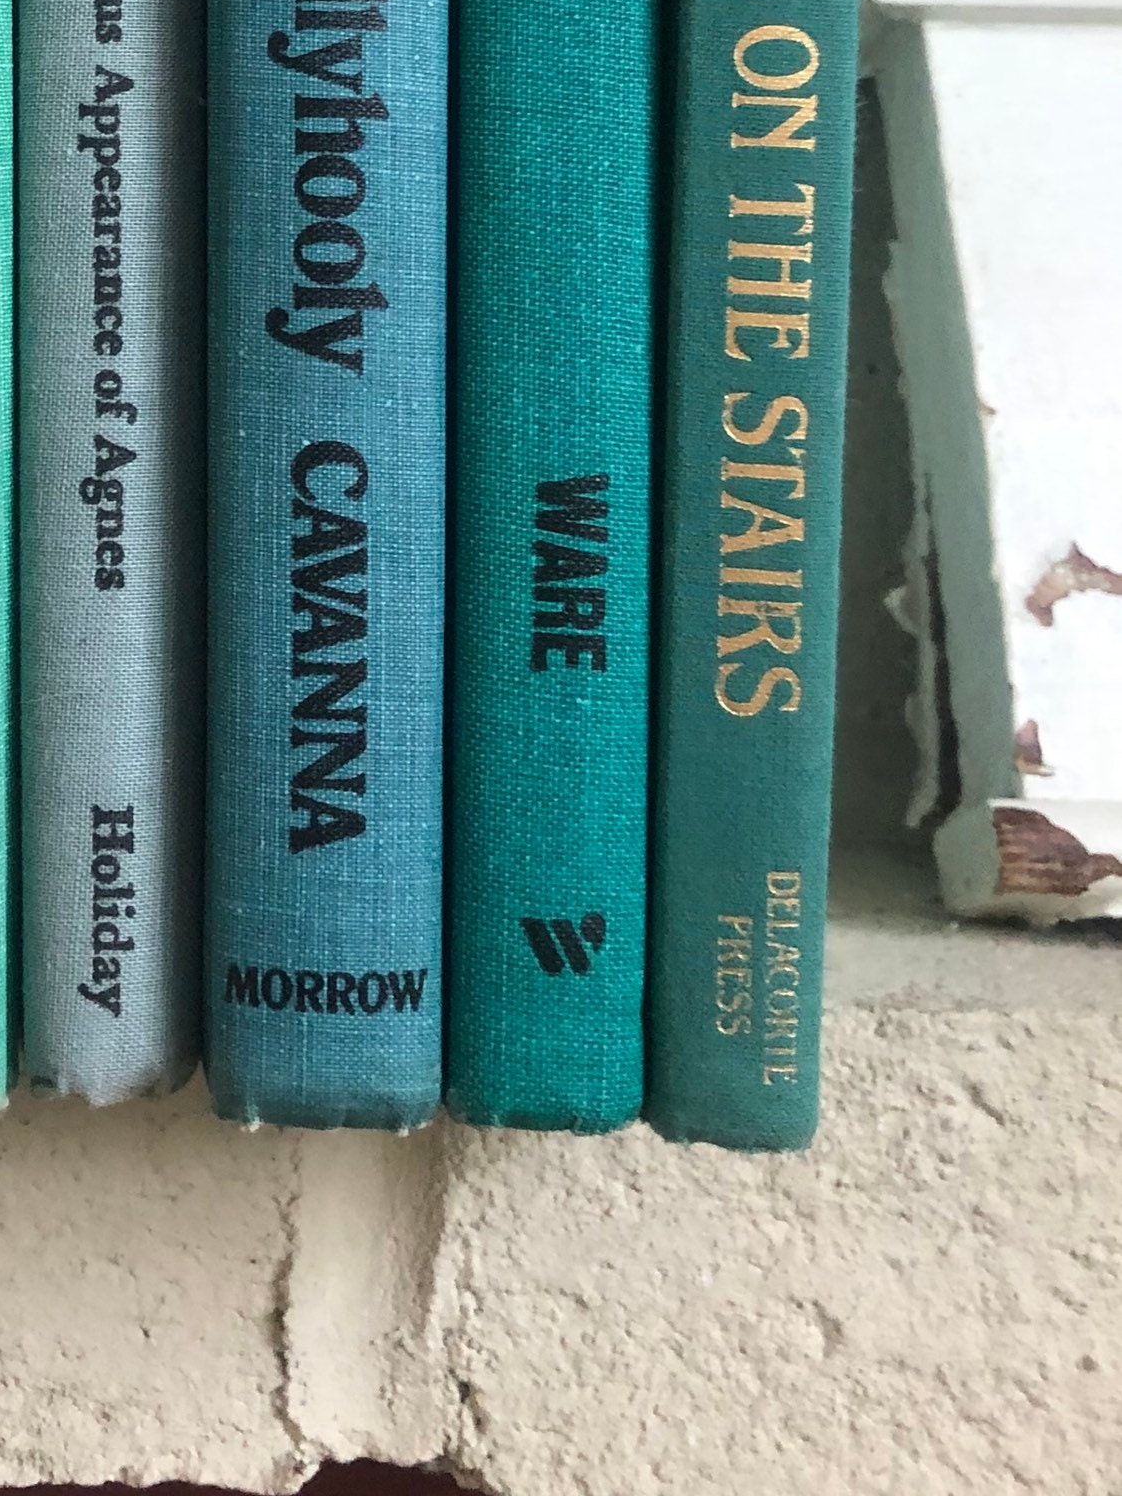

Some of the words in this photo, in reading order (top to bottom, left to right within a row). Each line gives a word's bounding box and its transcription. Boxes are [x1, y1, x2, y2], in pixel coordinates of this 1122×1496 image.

[730, 24, 820, 152] ON
[78, 67, 136, 359] Appearance
[724, 183, 816, 362] THE
[92, 371, 138, 425] of
[78, 435, 139, 592] Agnes
[530, 472, 610, 673] WARE
[713, 391, 810, 718] STAIRS
[289, 440, 370, 855] CAVANNA
[78, 804, 135, 1018] Holiday
[224, 963, 428, 1015] MORROW
[715, 914, 754, 1036] PRESS
[763, 871, 802, 1086] DELACORTE
